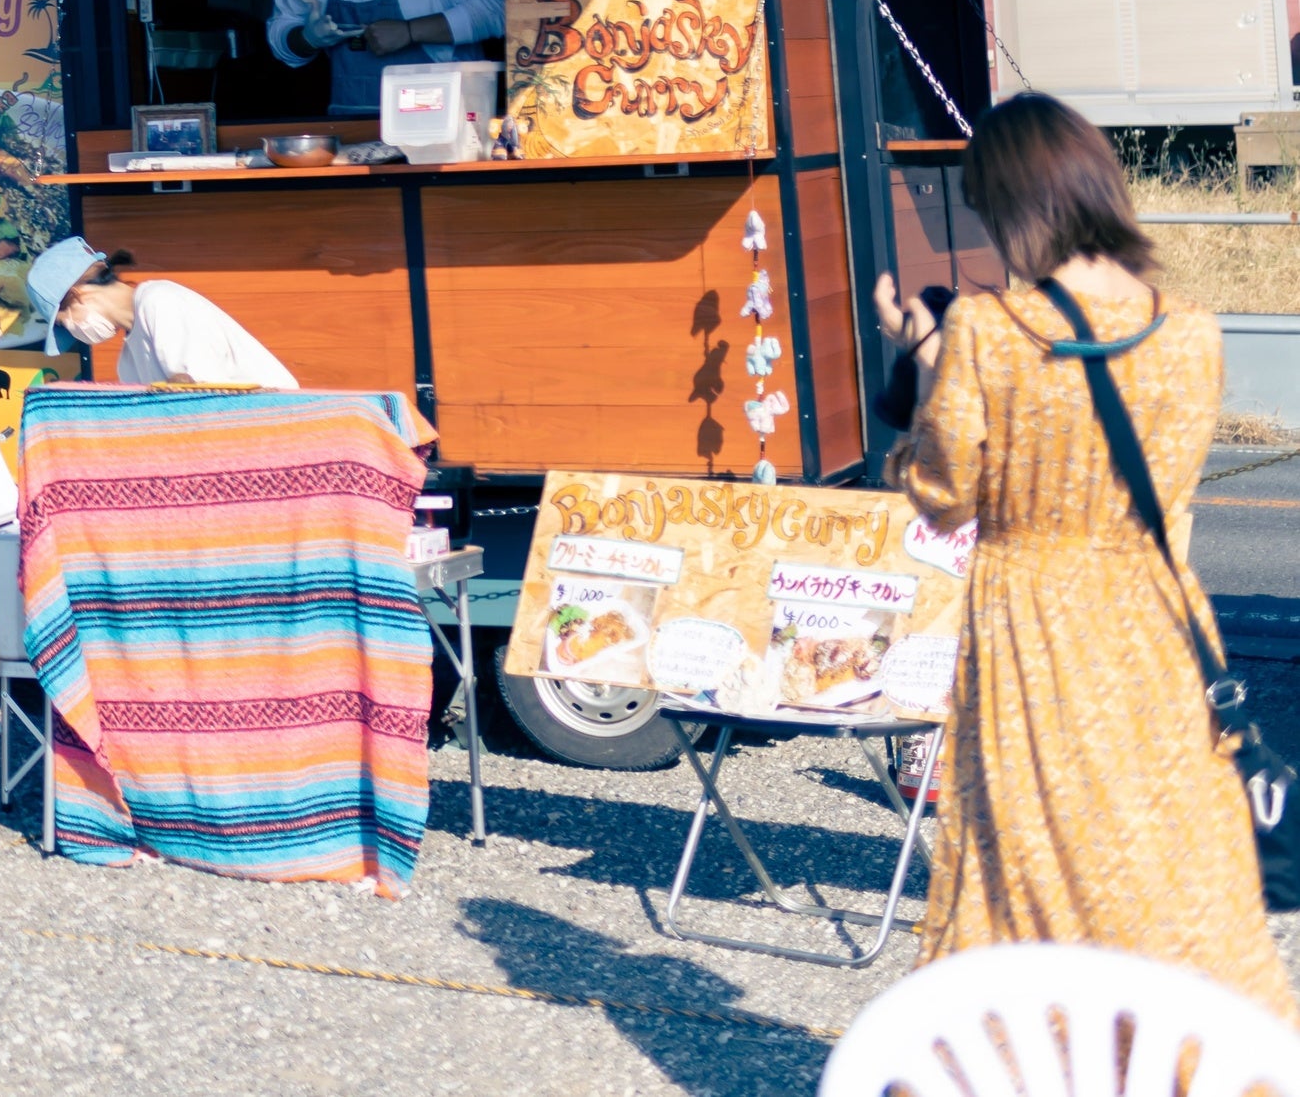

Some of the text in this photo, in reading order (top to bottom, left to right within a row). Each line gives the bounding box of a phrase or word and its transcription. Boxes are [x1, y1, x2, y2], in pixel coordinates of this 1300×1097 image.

[572, 61, 728, 124] Curry
[551, 481, 770, 550] Bonjasky
[771, 498, 890, 567] Curry
[554, 541, 676, 578] クリーミーチキンカレー
